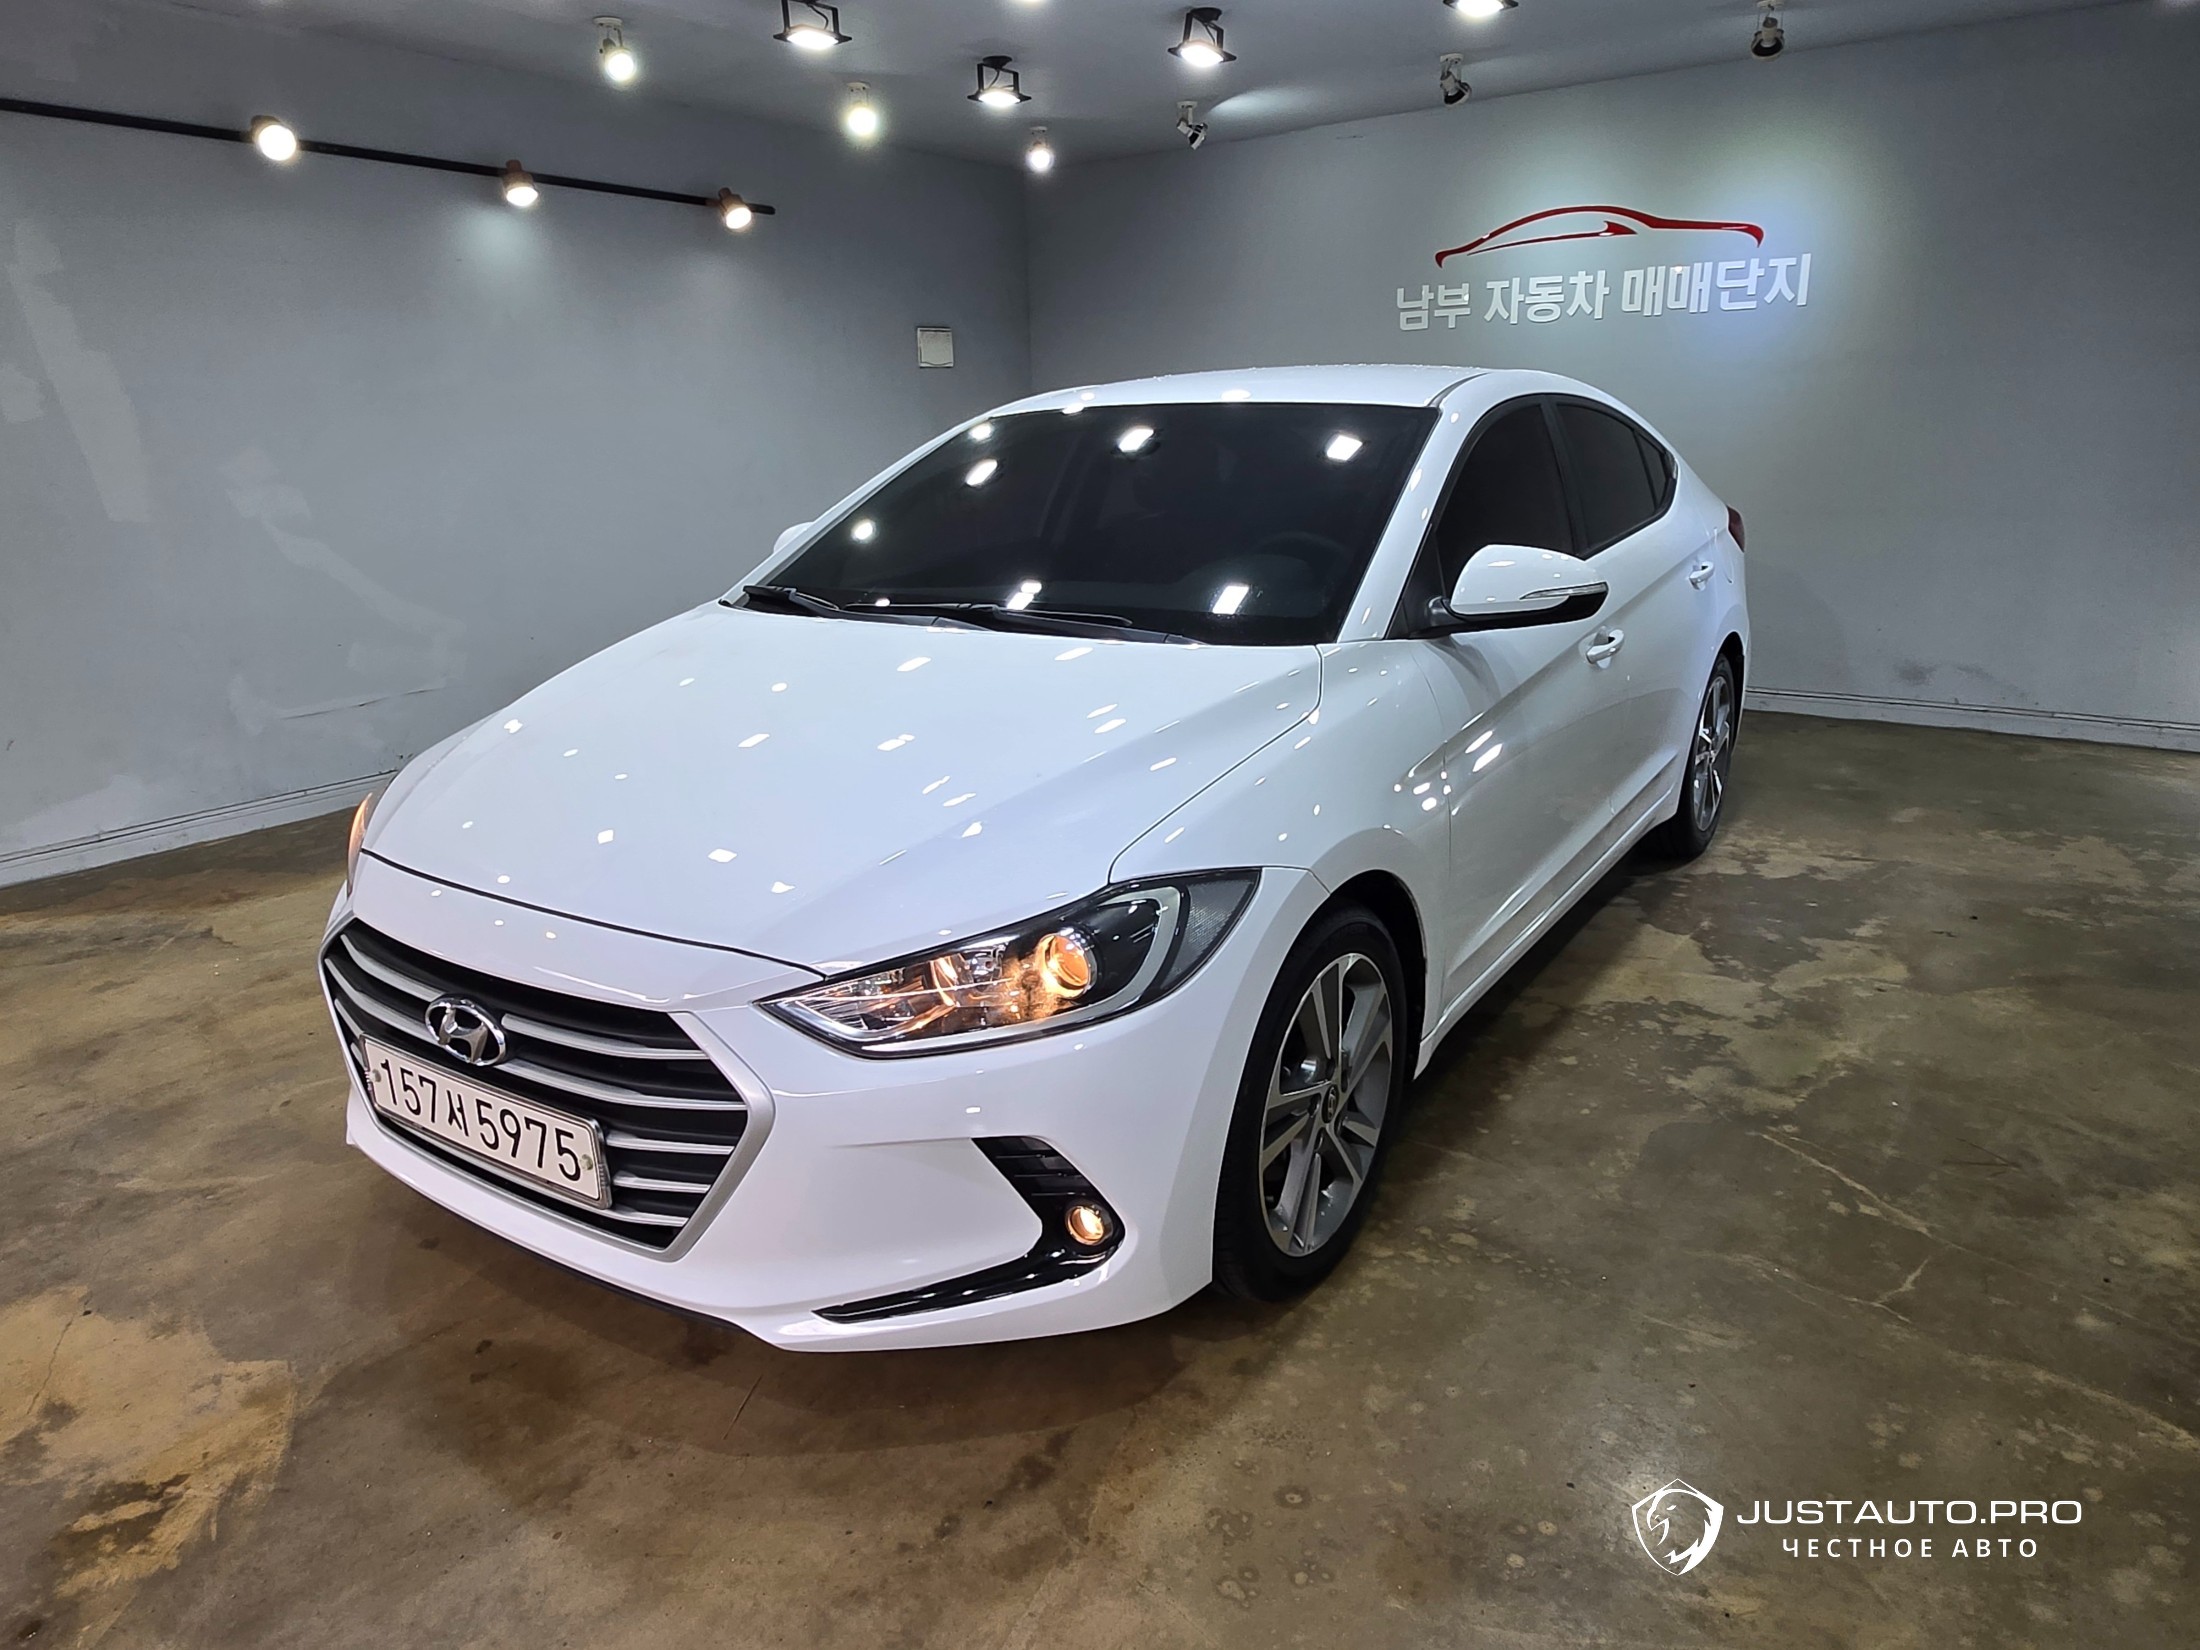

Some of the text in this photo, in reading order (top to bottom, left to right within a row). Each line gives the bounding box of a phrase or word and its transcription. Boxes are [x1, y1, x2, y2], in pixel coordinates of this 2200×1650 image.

[1396, 252, 1811, 331] 남부 자동차 매매단지
